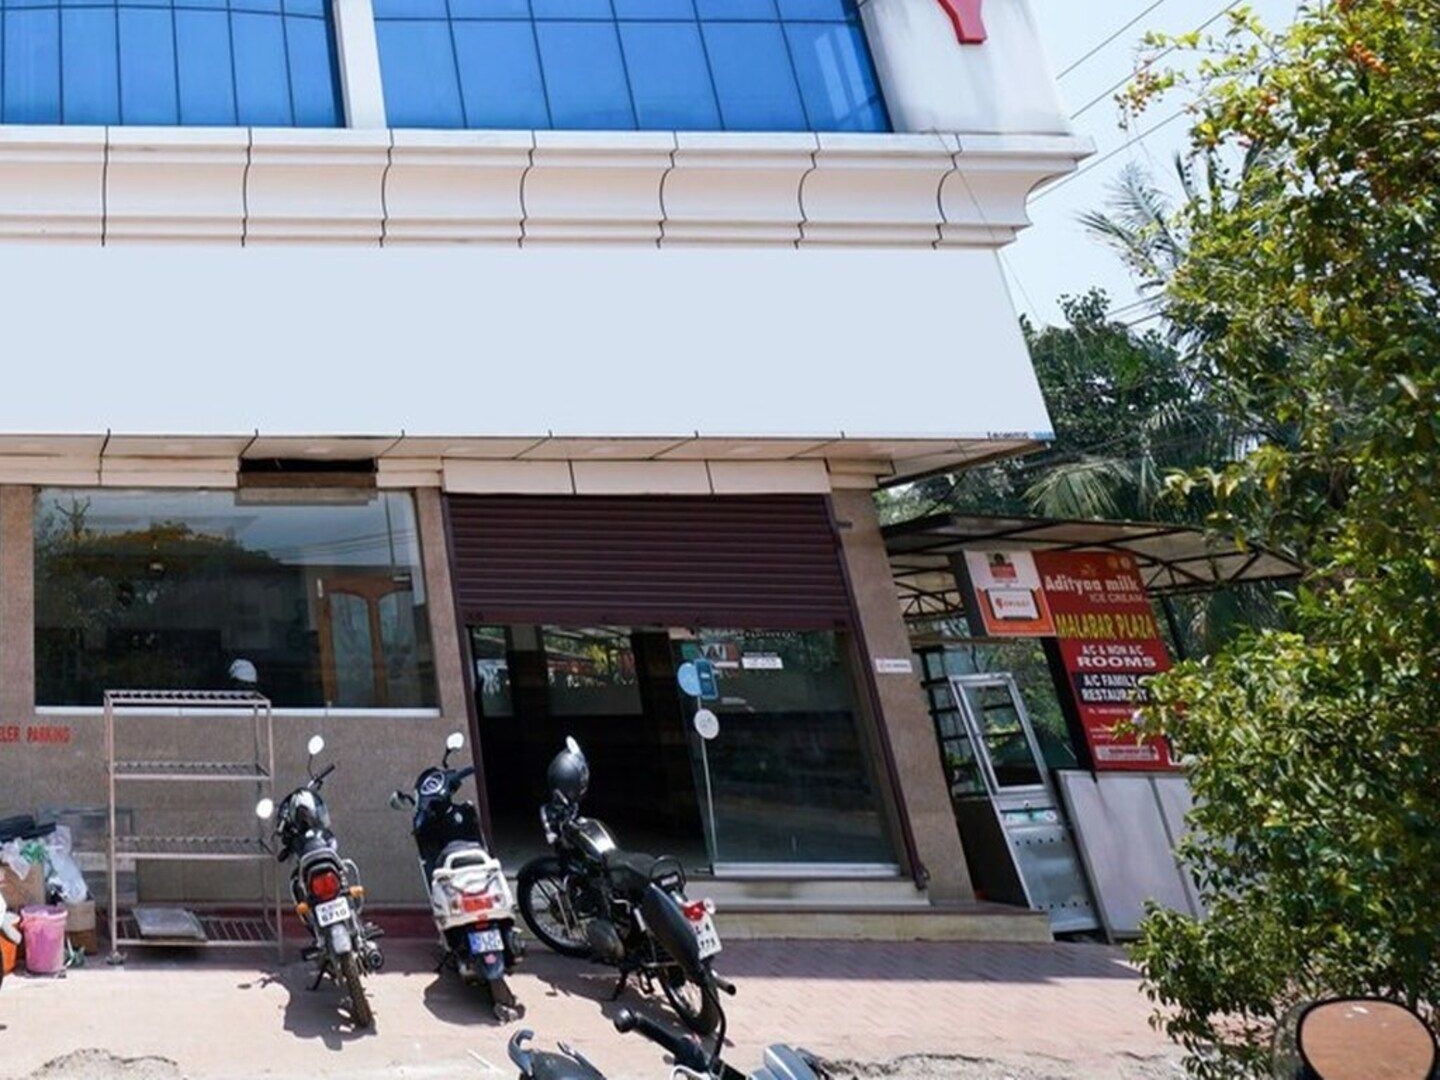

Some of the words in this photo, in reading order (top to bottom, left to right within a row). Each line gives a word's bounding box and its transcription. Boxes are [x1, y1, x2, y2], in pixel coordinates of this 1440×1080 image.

[1105, 574, 1140, 591] milk
[1055, 614, 1117, 639] MALABAR
[1115, 614, 1157, 639] PLAZA
[1076, 656, 1157, 668] ROOMS
[26, 726, 71, 742] PARKING
